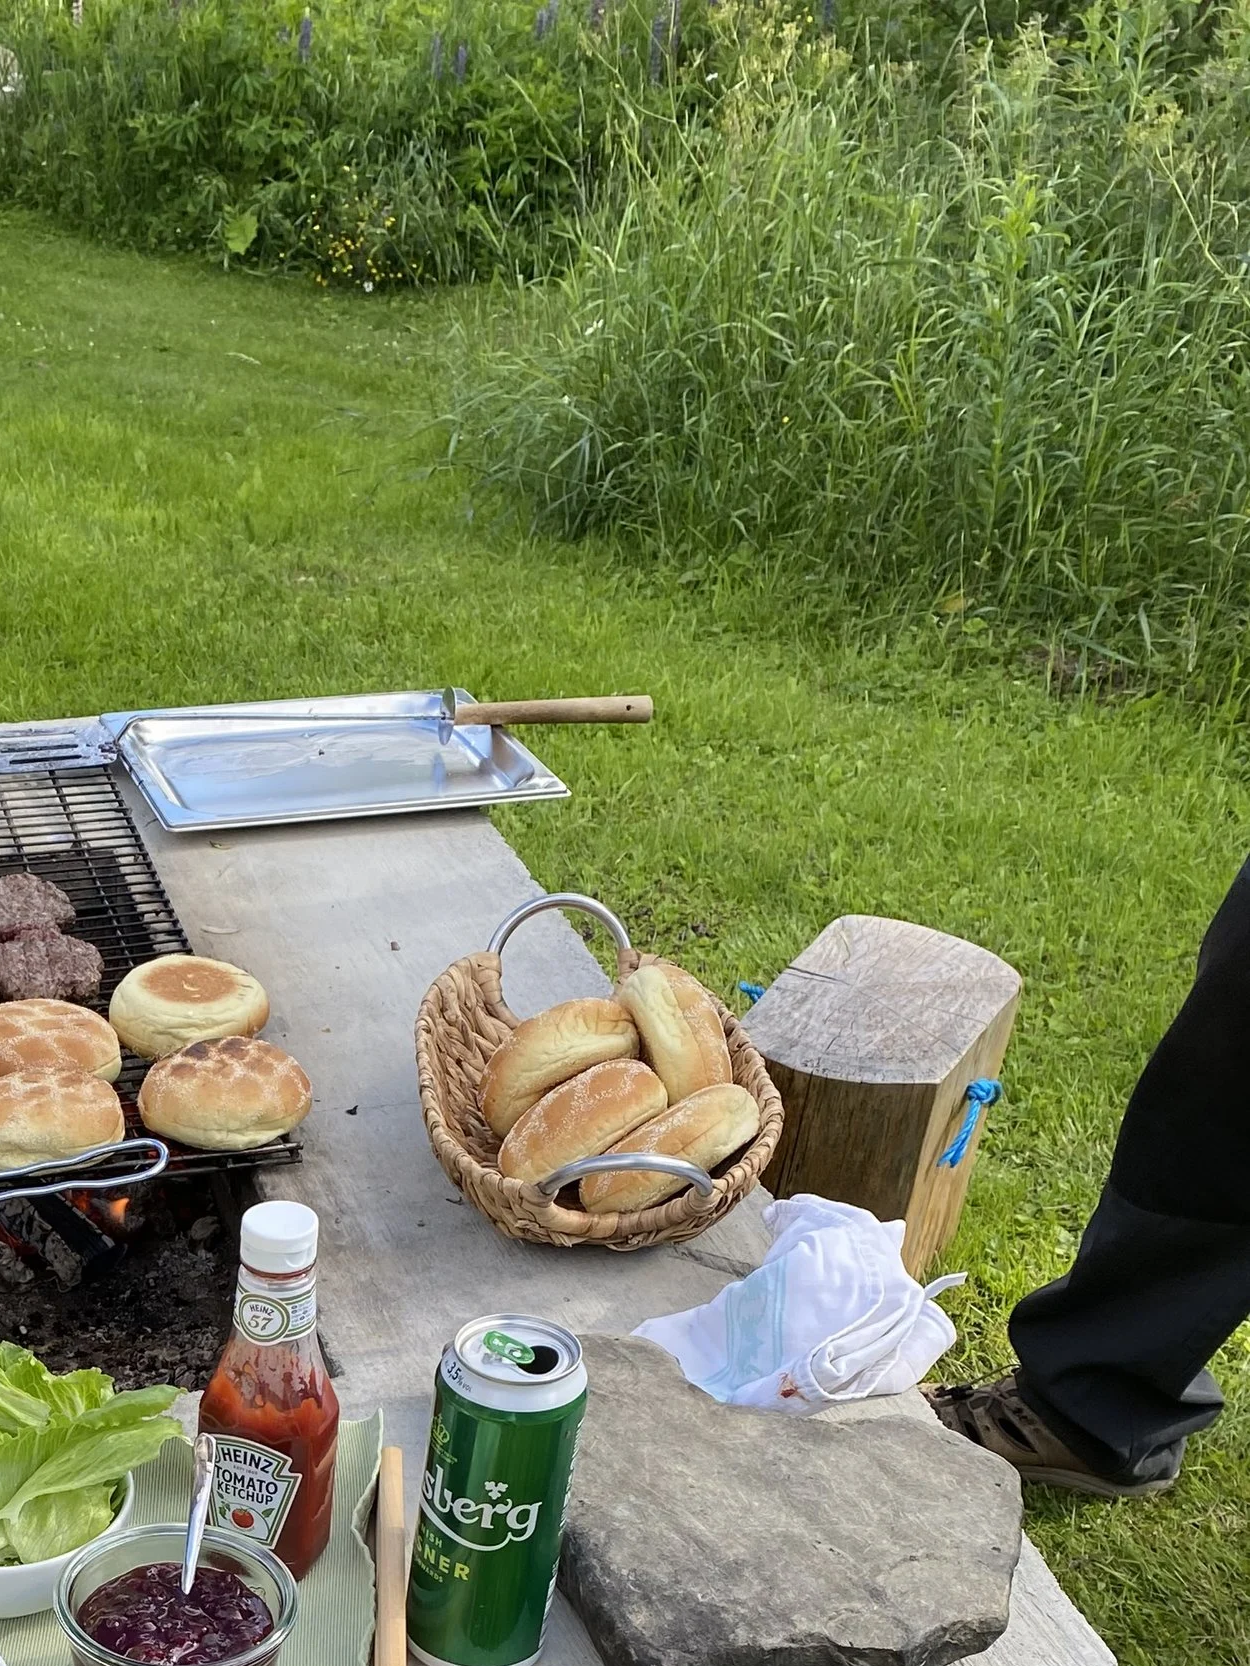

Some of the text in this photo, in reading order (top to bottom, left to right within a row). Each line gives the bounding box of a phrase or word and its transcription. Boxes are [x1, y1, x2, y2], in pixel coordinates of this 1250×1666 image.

[249, 1304, 274, 1316] HEINZ
[248, 1315, 273, 1331] 57
[221, 1447, 273, 1473] HEINZ
[215, 1464, 278, 1495] TOMATO
[217, 1481, 273, 1505] KETCHUP
